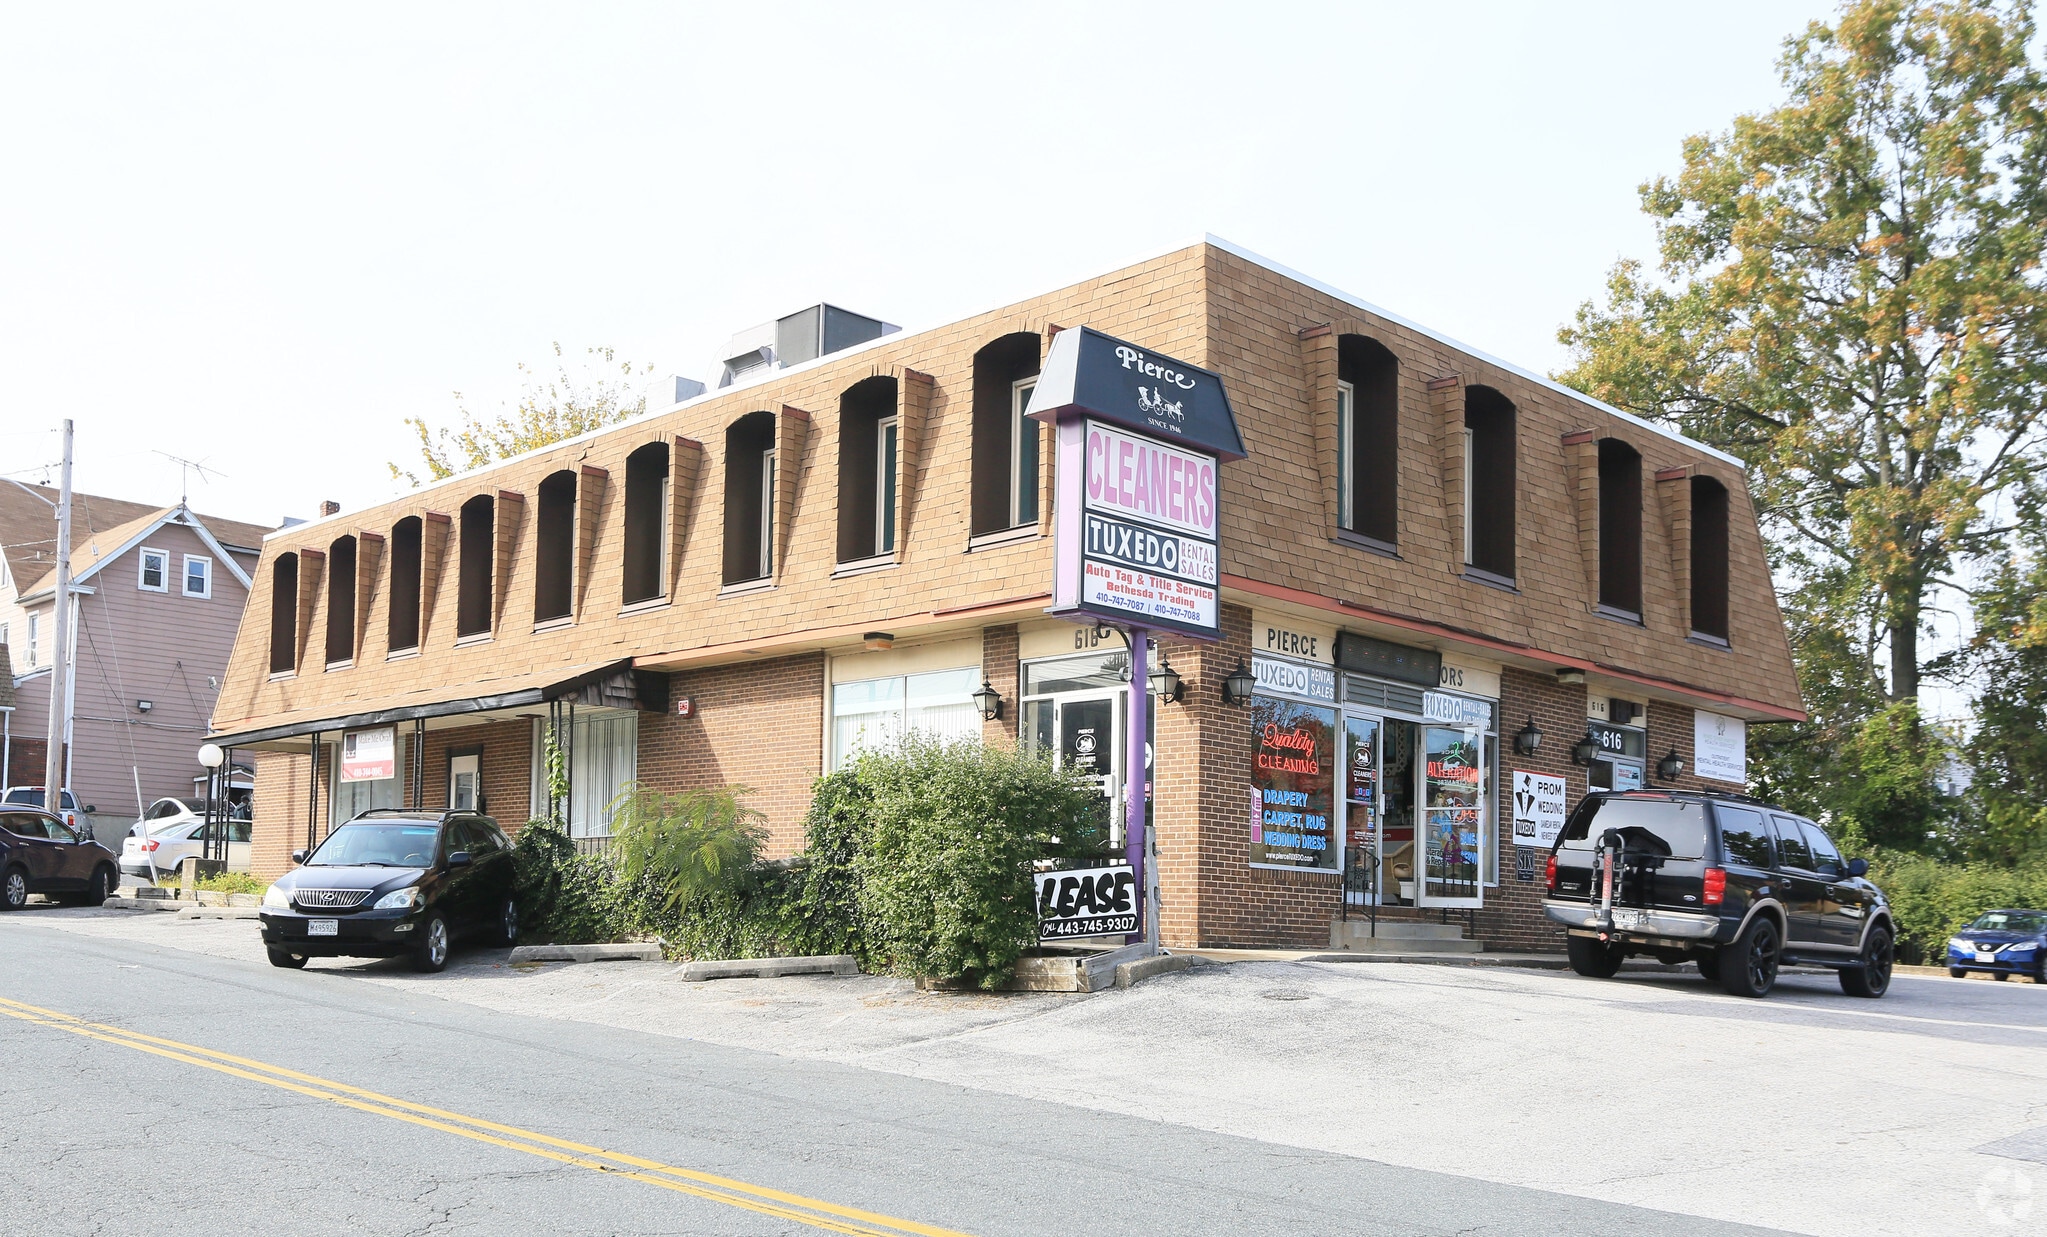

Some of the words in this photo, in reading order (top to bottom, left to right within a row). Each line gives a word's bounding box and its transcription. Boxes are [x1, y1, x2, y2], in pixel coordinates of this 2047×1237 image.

[1115, 346, 1196, 390] Pierce
[1147, 417, 1168, 430] SINCE
[1169, 424, 1182, 434] 1946
[1087, 431, 1214, 530] CLEANERS
[1090, 520, 1178, 570] TUXEDO
[1181, 541, 1215, 564] RENTAL
[1181, 559, 1215, 581] SALES
[1086, 563, 1110, 578] Auto
[1115, 569, 1133, 585] Tag
[1136, 574, 1145, 585] &
[1149, 576, 1172, 591] Title
[1176, 583, 1213, 600] Service
[1106, 581, 1154, 599] Bethesda
[1158, 592, 1195, 609] Trading
[1096, 592, 1144, 611] 410-747-7087
[1154, 604, 1201, 621] 410-747-7088
[1267, 628, 1317, 657] PIERCE
[1254, 662, 1306, 690] TUXEDO
[1310, 668, 1335, 685] RENTAL
[1310, 684, 1334, 699] SALES
[1425, 694, 1461, 721] TUXEDO
[1263, 723, 1315, 757] Quality
[1602, 730, 1622, 750] 616
[1258, 753, 1319, 775] CLEANING
[1353, 770, 1372, 778] CLEANERS
[1263, 789, 1309, 808] DRAPERY
[1537, 781, 1562, 797] PROM
[1537, 801, 1563, 815] WEDDING
[1263, 810, 1303, 832] CARPET,
[1305, 814, 1327, 831] RUG
[1516, 820, 1536, 836] TUXEDO
[1263, 831, 1301, 849] WEDDING
[1301, 834, 1327, 851] DRESS
[1518, 854, 1534, 870] SIX
[1040, 872, 1134, 918] LEASE
[1057, 917, 1136, 935] 443-745-9307
